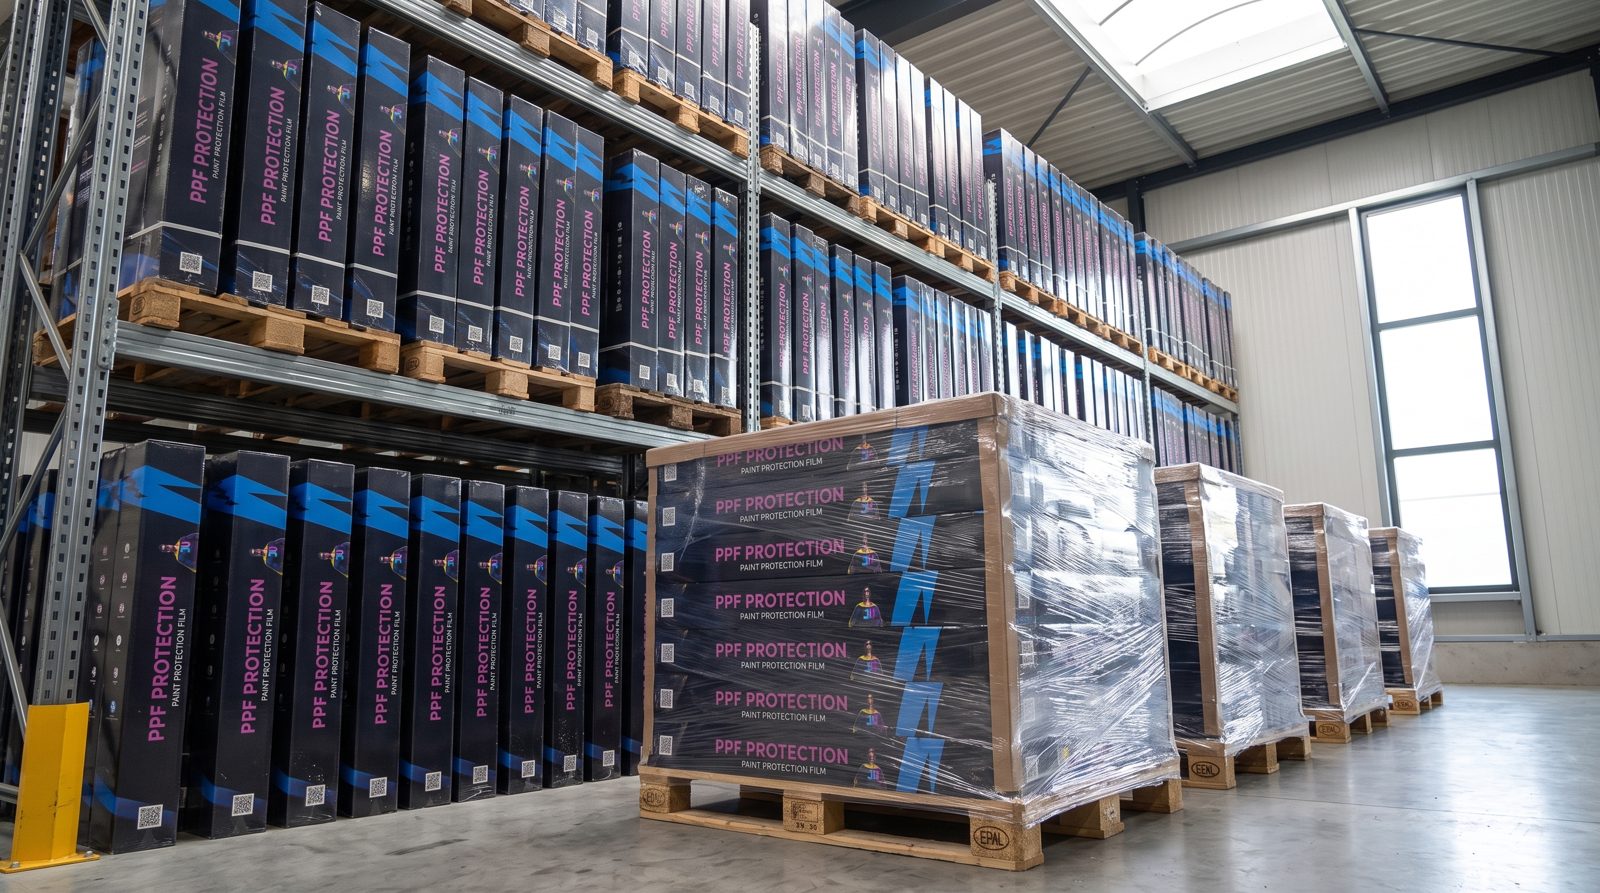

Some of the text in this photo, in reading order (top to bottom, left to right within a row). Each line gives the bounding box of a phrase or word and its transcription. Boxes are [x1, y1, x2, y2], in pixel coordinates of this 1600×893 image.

[190, 58, 218, 204] PPF PROTECTION
[214, 109, 224, 157] PROTECTION
[261, 86, 285, 225] PPF PROTECTION
[282, 136, 291, 183] PROTECTION
[319, 110, 340, 242] PPF PROTECTION
[373, 130, 392, 256] PPF PROTECTION
[435, 154, 450, 273] PPF PROTECTION
[474, 169, 489, 285] PPF PROTECTION
[515, 186, 529, 296] PPF PROTECTION
[553, 199, 565, 307] PPF PROTECTION
[582, 210, 593, 316] PPF PROTECTION
[642, 230, 651, 304] PROTECTION
[669, 242, 677, 314] PROTECTION
[717, 437, 844, 467] PPF PROTECTION
[741, 466, 760, 474] PAINT
[761, 460, 804, 471] PROTECTION
[716, 486, 844, 515] PPF PROTECTION
[740, 508, 823, 522] PAINT PROTECTION FILM
[716, 539, 845, 562] PPF PROTECTION
[740, 563, 759, 571] PAINT
[760, 561, 804, 570] PROTECTION
[716, 590, 846, 609] PPF PROTECTION
[740, 612, 759, 620] PAINT
[147, 576, 177, 742] PPF PROTECTION
[172, 609, 186, 707] PAINT PROTECTION FILM
[241, 579, 264, 733] PPF PROTECTION
[263, 629, 272, 677] PROTECTION
[312, 582, 333, 728] PPF PROTECTION
[331, 629, 340, 675] PROTECTION
[375, 584, 392, 724] PPF PROTECTION
[430, 586, 445, 720] PPF PROTECTION
[477, 587, 490, 717] PPF PROTECTION
[525, 589, 536, 713] PPF PROTECTION
[566, 590, 577, 710] PPF PROTECTION
[605, 592, 615, 707] PPF PROTECTION
[716, 642, 847, 658] PPF PROTECTION
[741, 661, 825, 670] PAINT PROTECTION FILM
[261, 679, 269, 701] PAINT
[330, 679, 338, 698] PAINT
[716, 691, 848, 711] PPF PROTECTION
[762, 711, 807, 721] PROTECTION
[809, 714, 826, 722] FILM
[715, 739, 848, 764] PPF PROTECTION
[741, 760, 826, 775] PAINT PROTECTION FILM
[980, 830, 1004, 846] EPAL
